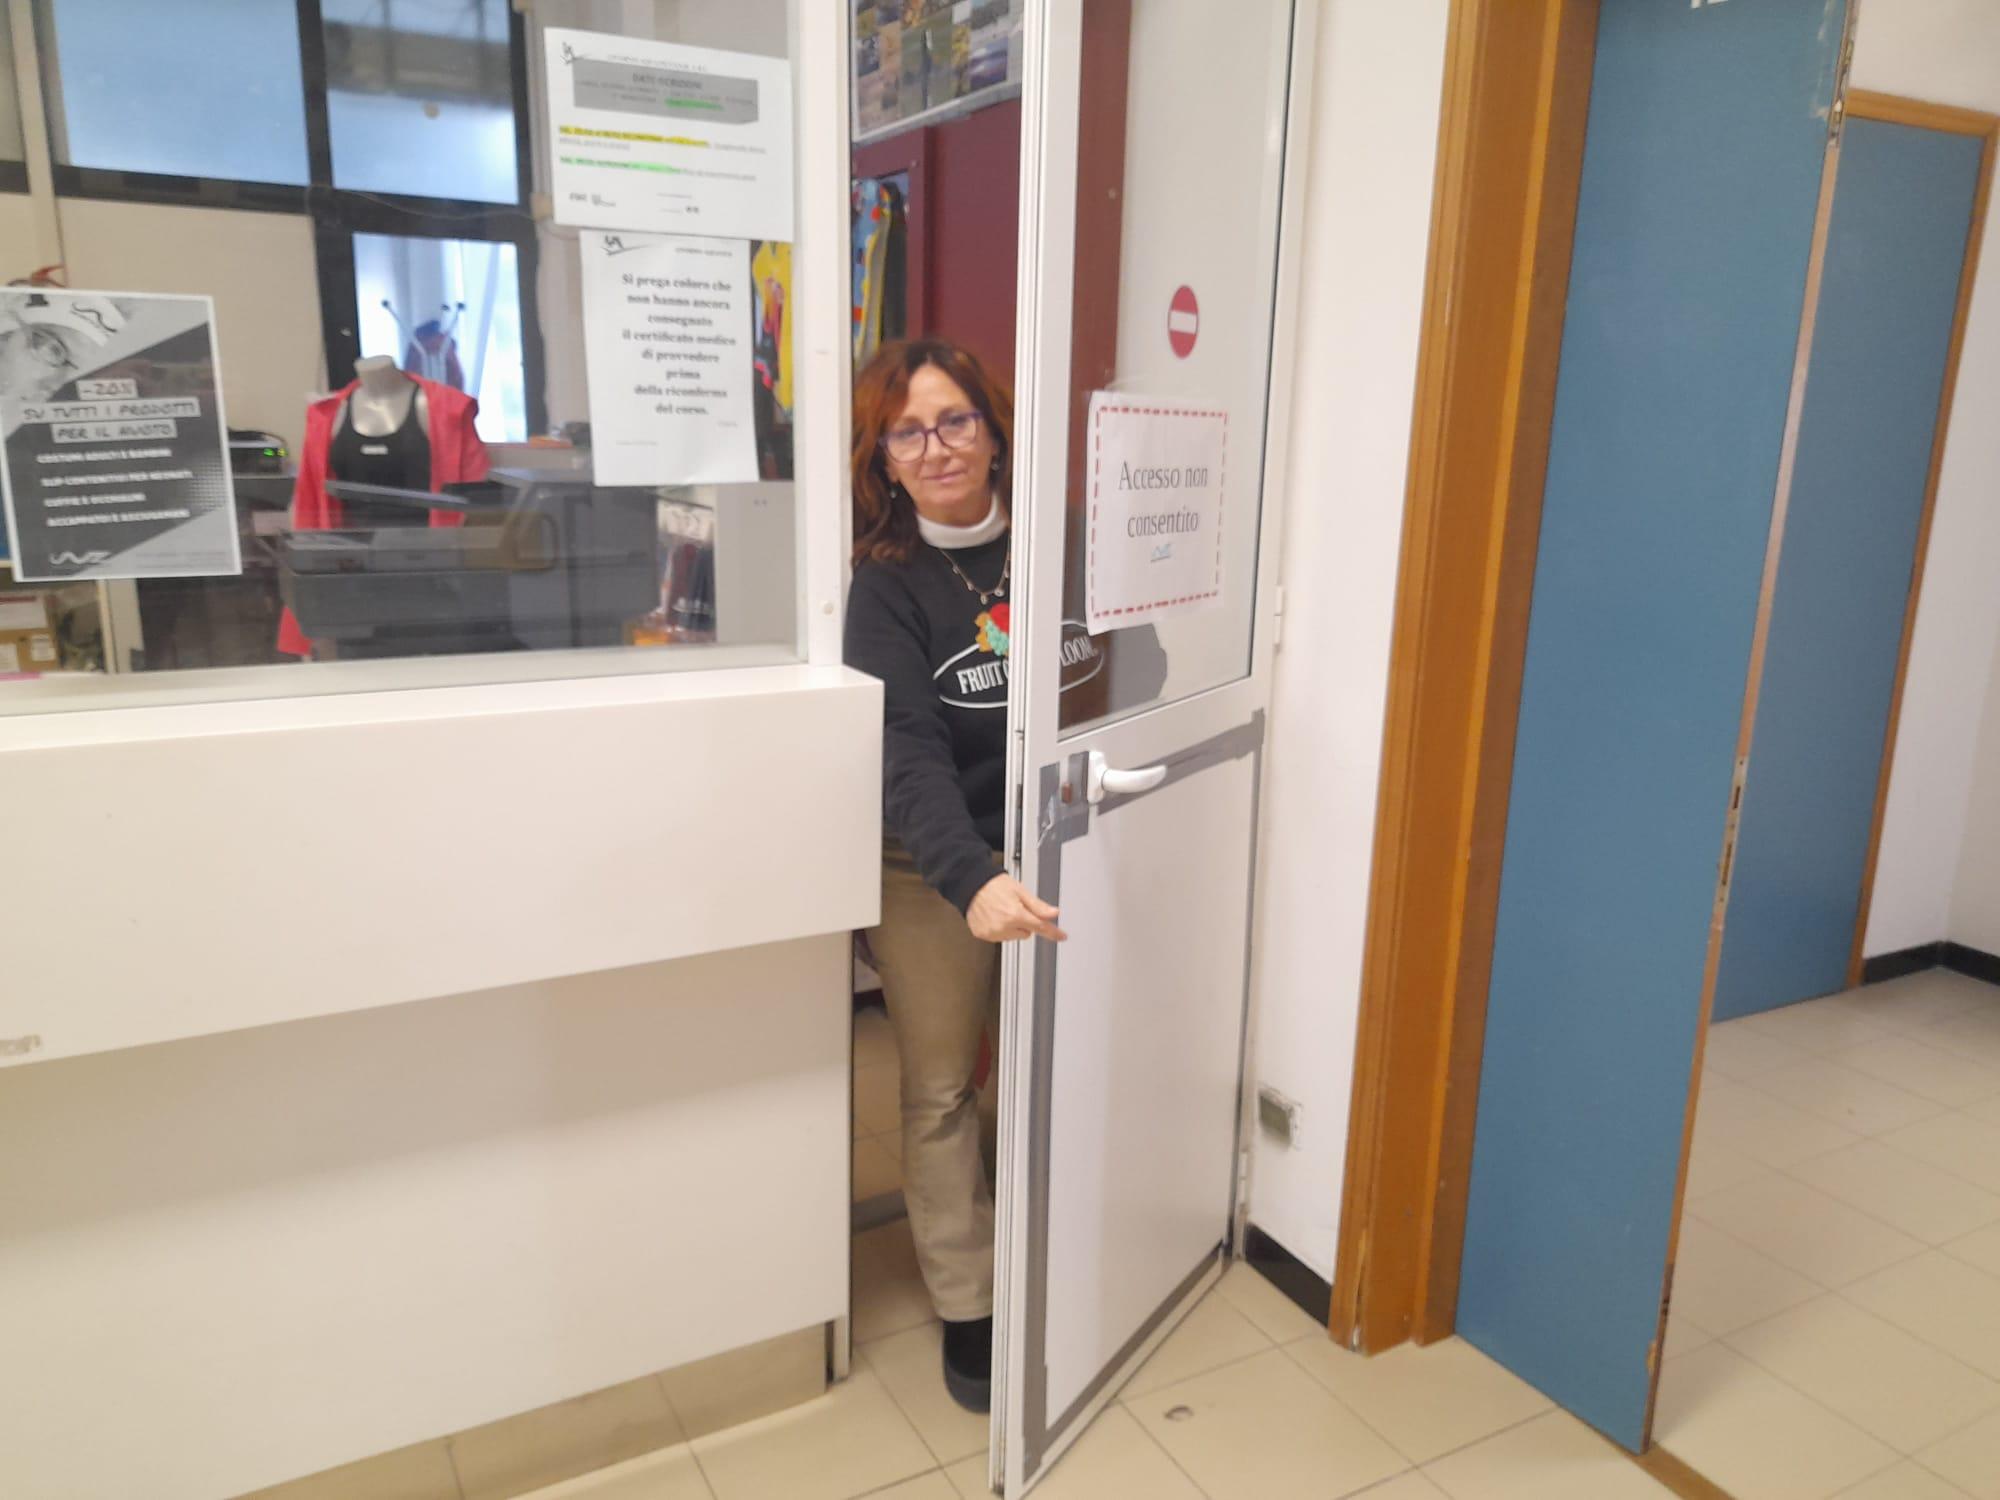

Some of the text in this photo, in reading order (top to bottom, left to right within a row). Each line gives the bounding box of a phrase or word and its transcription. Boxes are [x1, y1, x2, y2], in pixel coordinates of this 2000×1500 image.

[622, 273, 732, 291] Si prega coloro che
[627, 294, 731, 310] non hanno ancora
[647, 314, 713, 327] consegnato
[622, 328, 736, 346] il certificato medico
[641, 348, 720, 364] di provvedere
[666, 367, 701, 381] prima
[633, 384, 729, 399] della riconferma
[53, 405, 98, 418] TUTTI
[119, 402, 195, 416] PRODOTTI
[655, 402, 673, 414] del
[57, 427, 89, 440] PER
[1118, 460, 1210, 491] Accesso non
[1126, 505, 1200, 539] consentito
[956, 660, 1004, 694] FRUIT
